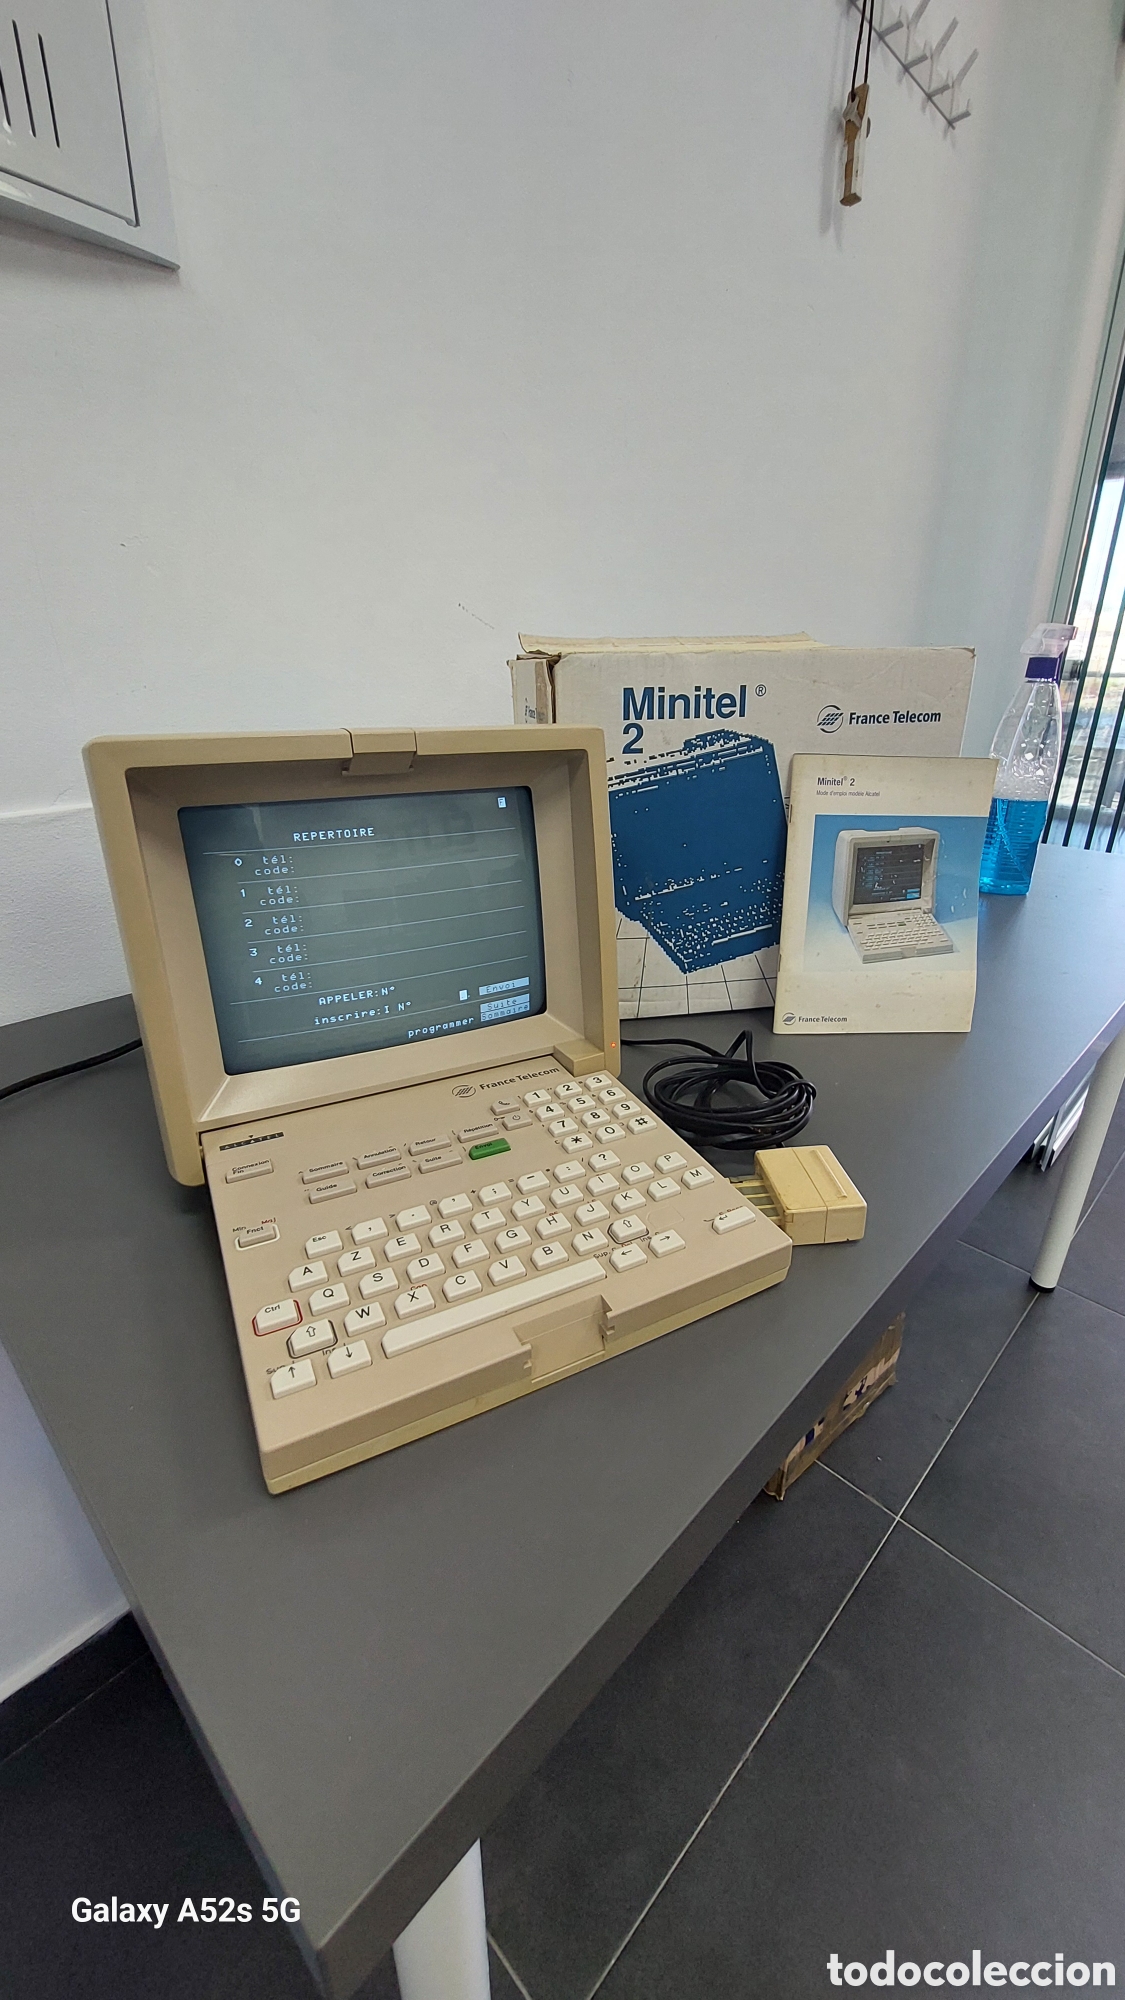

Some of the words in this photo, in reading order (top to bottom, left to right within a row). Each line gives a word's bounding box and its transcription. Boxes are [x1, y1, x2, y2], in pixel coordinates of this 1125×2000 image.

[623, 684, 747, 721] Minitel
[848, 712, 890, 725] France
[892, 710, 942, 724] Telecom
[622, 722, 644, 754] 2
[849, 778, 856, 787] 2
[293, 827, 375, 842] REPERTOIRE
[263, 855, 293, 865] tél:
[255, 865, 295, 876] code:
[240, 888, 246, 898] 1
[267, 885, 298, 895] tél:
[260, 896, 299, 906] code:
[244, 918, 253, 927] 2
[272, 914, 303, 925] tél:
[264, 925, 304, 935] code:
[249, 948, 258, 957] 3
[277, 943, 307, 954] tél:
[269, 953, 309, 964] code:
[255, 977, 263, 985] 4
[281, 971, 312, 982] tél:
[274, 980, 313, 993] code:
[486, 981, 516, 993] Envoi
[487, 999, 517, 1010] Suite
[408, 1016, 474, 1038] programmer
[481, 1004, 529, 1020] Sommaire
[821, 1015, 848, 1023] Telecom
[479, 1077, 517, 1091] France
[516, 1067, 560, 1081] Telecom
[592, 1076, 603, 1084] 3
[562, 1084, 573, 1092] 2
[606, 1089, 616, 1097] 6
[576, 1097, 586, 1105] 5
[620, 1103, 631, 1111] 9
[590, 1111, 601, 1120] 8
[557, 1120, 566, 1128] 7
[415, 1138, 436, 1146] Retour
[474, 1142, 493, 1150] Envoi
[363, 1147, 397, 1159] Annulation
[664, 1154, 672, 1162] P
[424, 1155, 442, 1163] Suite
[231, 1159, 270, 1173] Connexion
[309, 1161, 344, 1173] Sommaire
[372, 1165, 407, 1177] Correction
[689, 1169, 702, 1178] M
[316, 1183, 338, 1192] Guide
[657, 1181, 667, 1189] L
[559, 1187, 570, 1195] U
[621, 1192, 632, 1201] K
[521, 1199, 531, 1207] Y
[586, 1204, 595, 1213] J
[481, 1211, 490, 1219] T
[546, 1216, 558, 1225] H
[246, 1226, 264, 1234] Fnct
[440, 1223, 451, 1233] R
[312, 1235, 327, 1243] Esc
[505, 1230, 518, 1239] G
[582, 1231, 594, 1241] N
[396, 1236, 406, 1246] E
[463, 1243, 472, 1253] F
[542, 1246, 553, 1255] B
[351, 1251, 361, 1261] Z
[418, 1258, 430, 1267] D
[498, 1259, 508, 1269] V
[302, 1266, 313, 1276] A
[372, 1272, 383, 1282] S
[455, 1275, 467, 1285] C
[322, 1288, 334, 1298] Q
[407, 1290, 419, 1302] X
[264, 1303, 281, 1314] Ctrl
[355, 1306, 371, 1319] W
